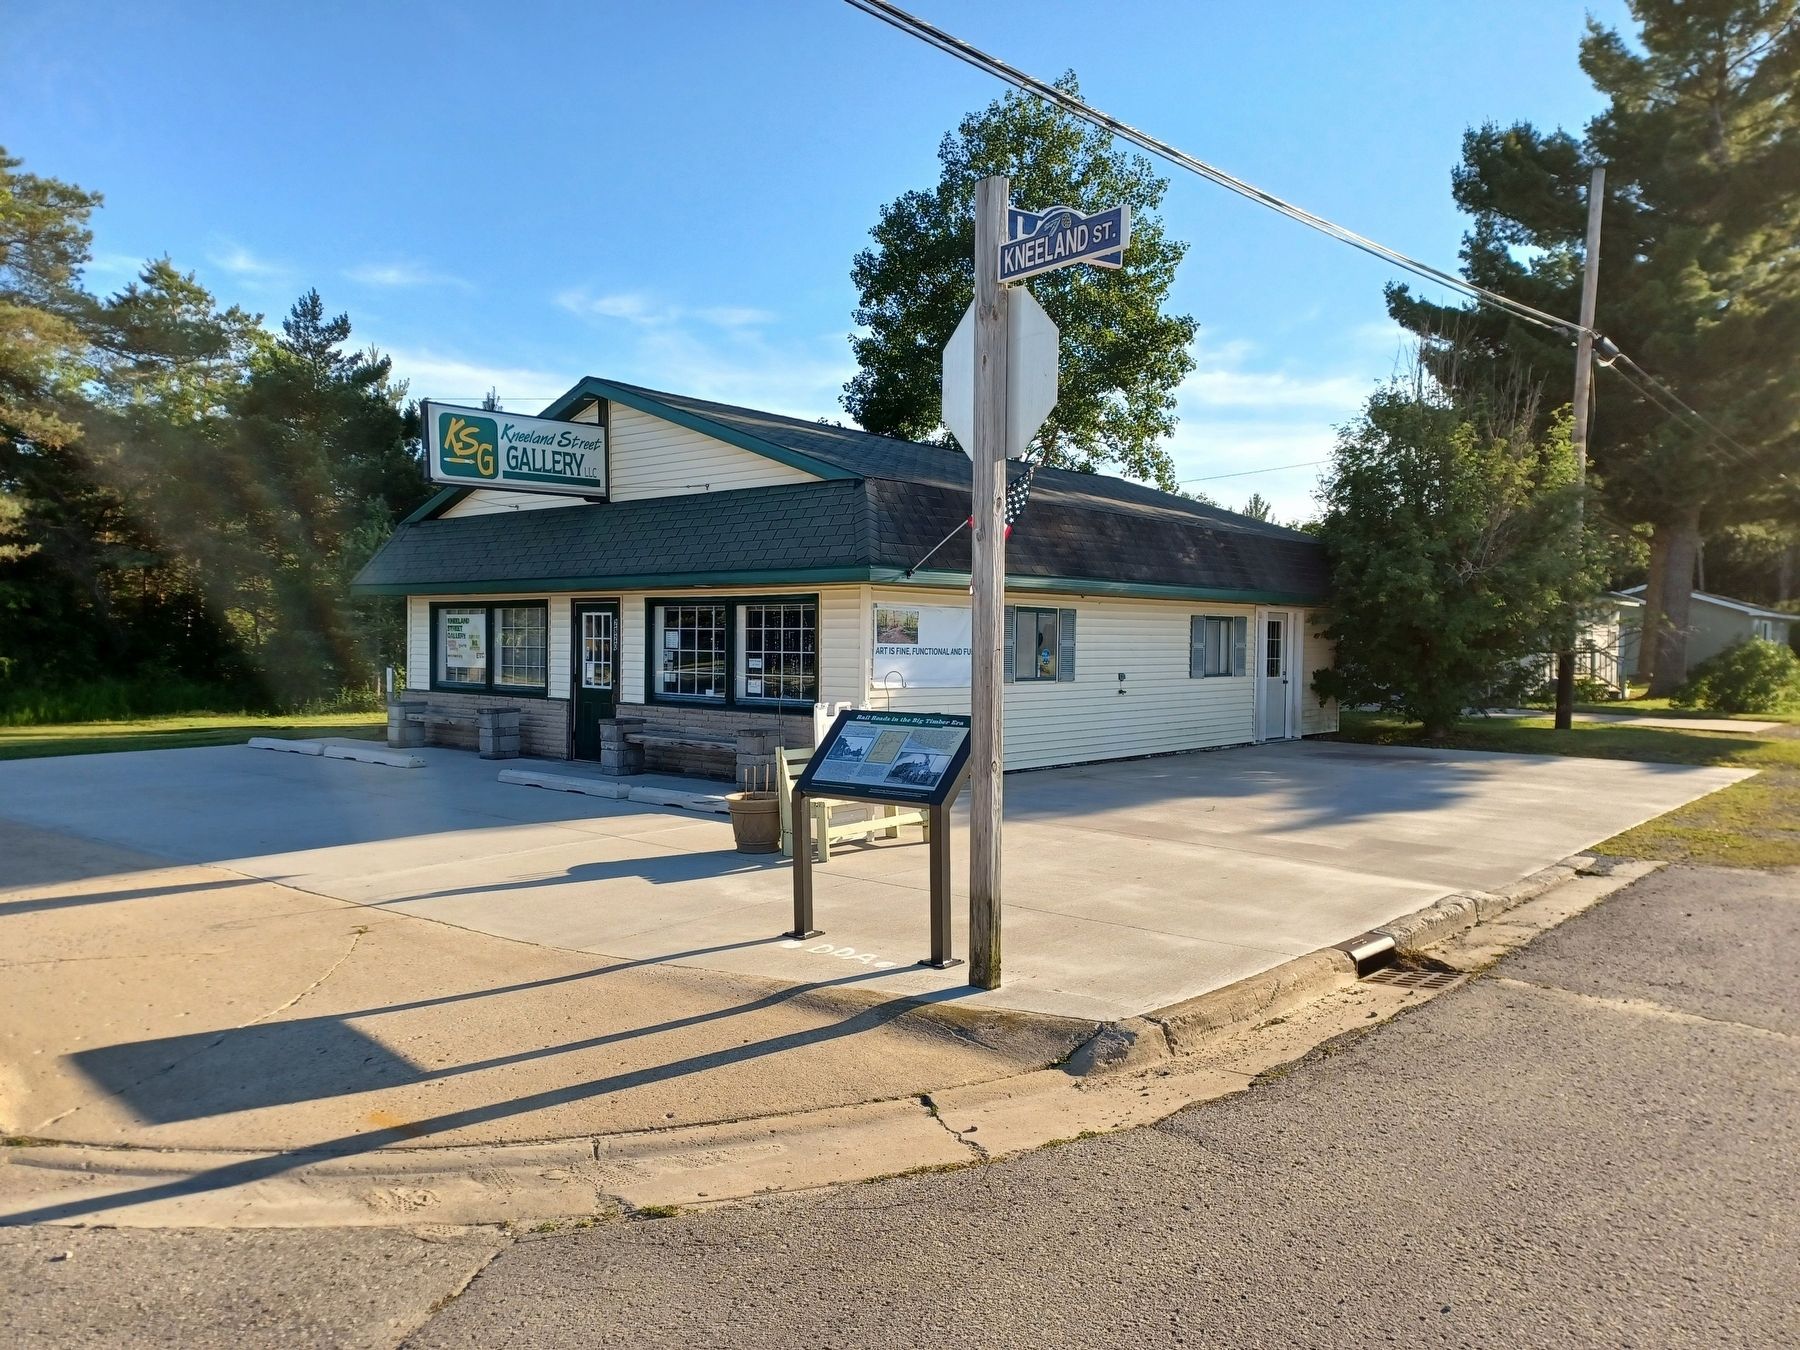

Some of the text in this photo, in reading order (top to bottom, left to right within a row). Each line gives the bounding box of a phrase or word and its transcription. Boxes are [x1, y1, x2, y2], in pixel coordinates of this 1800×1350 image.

[1004, 221, 1116, 274] KNEELAND ST.
[444, 417, 493, 476] KSG
[501, 423, 602, 451] Kneeland Street
[506, 446, 597, 478] GALLERY LLC
[875, 647, 972, 656] ART IS FINE, FUNCTIONAL AND FU
